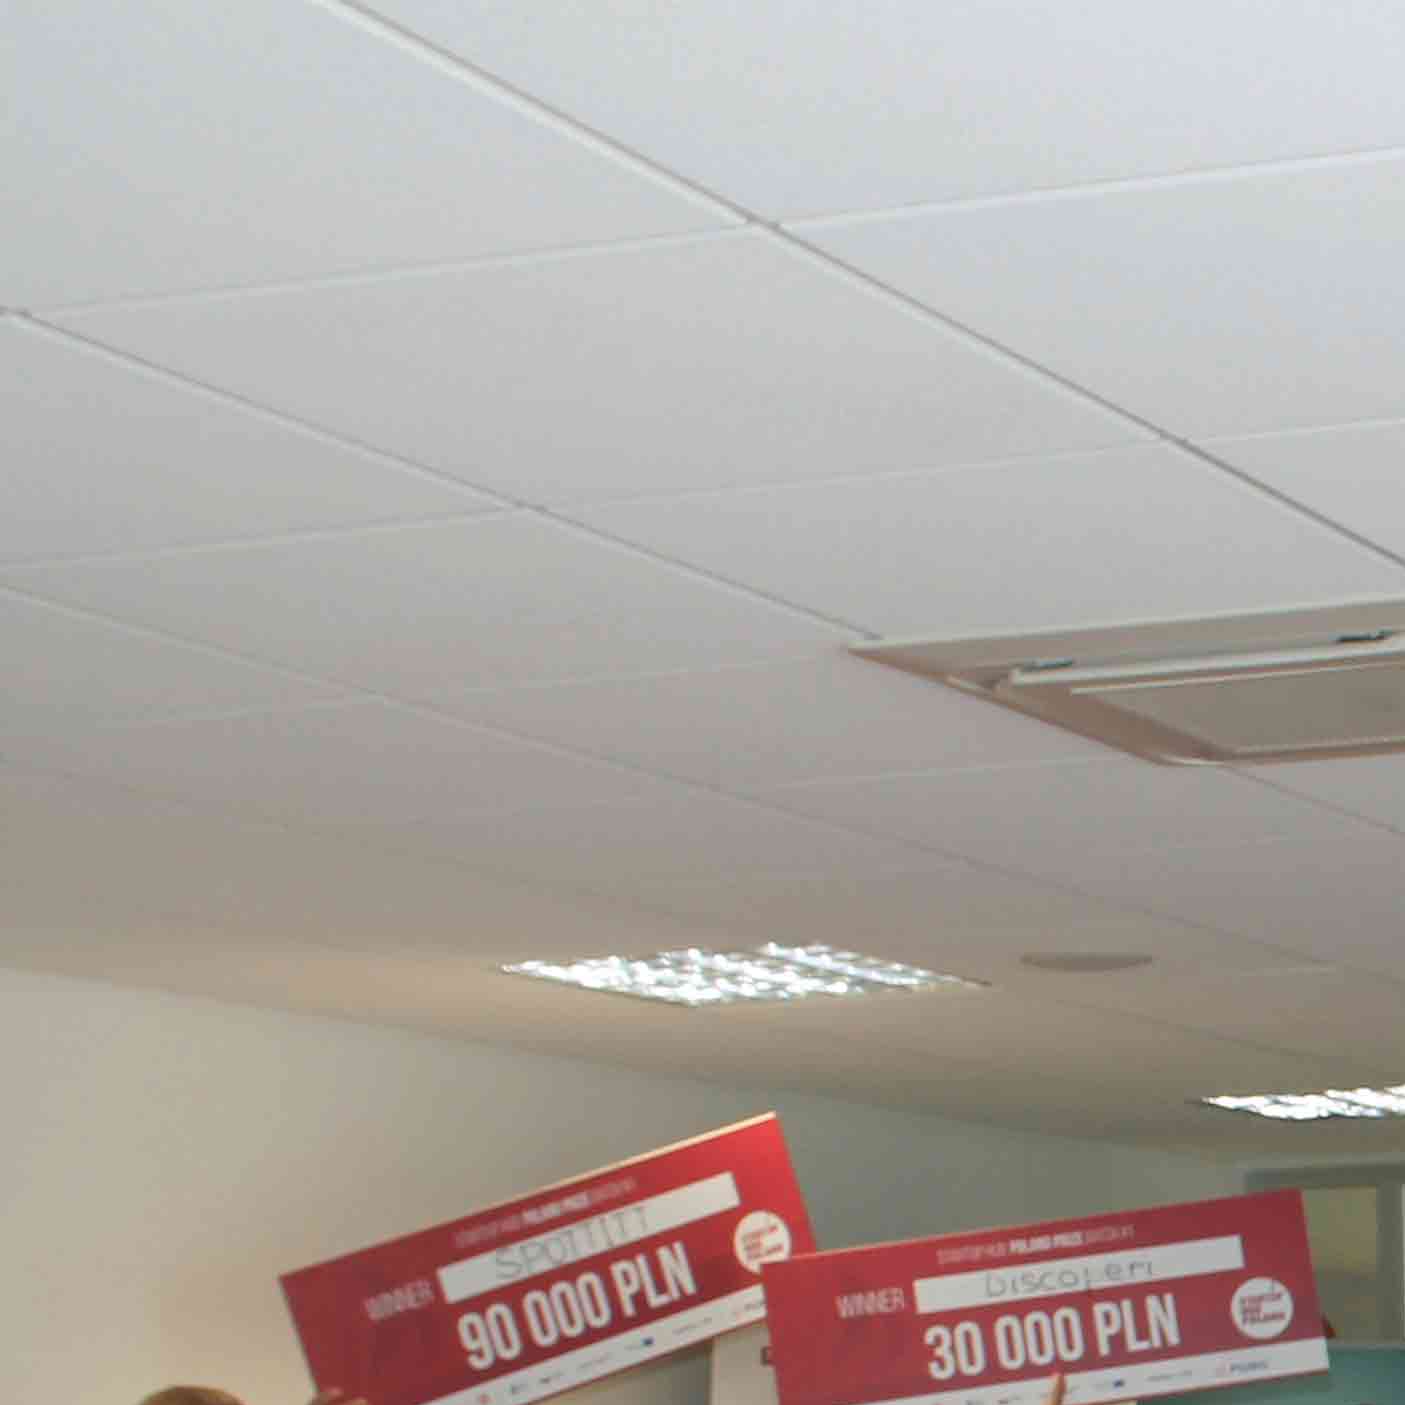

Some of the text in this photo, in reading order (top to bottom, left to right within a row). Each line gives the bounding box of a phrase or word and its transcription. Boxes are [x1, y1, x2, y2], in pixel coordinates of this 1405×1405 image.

[458, 1302, 522, 1371] 90
[522, 1272, 613, 1346] 000
[613, 1241, 698, 1317] PLN
[924, 1292, 1181, 1380] 30 000 PLN
